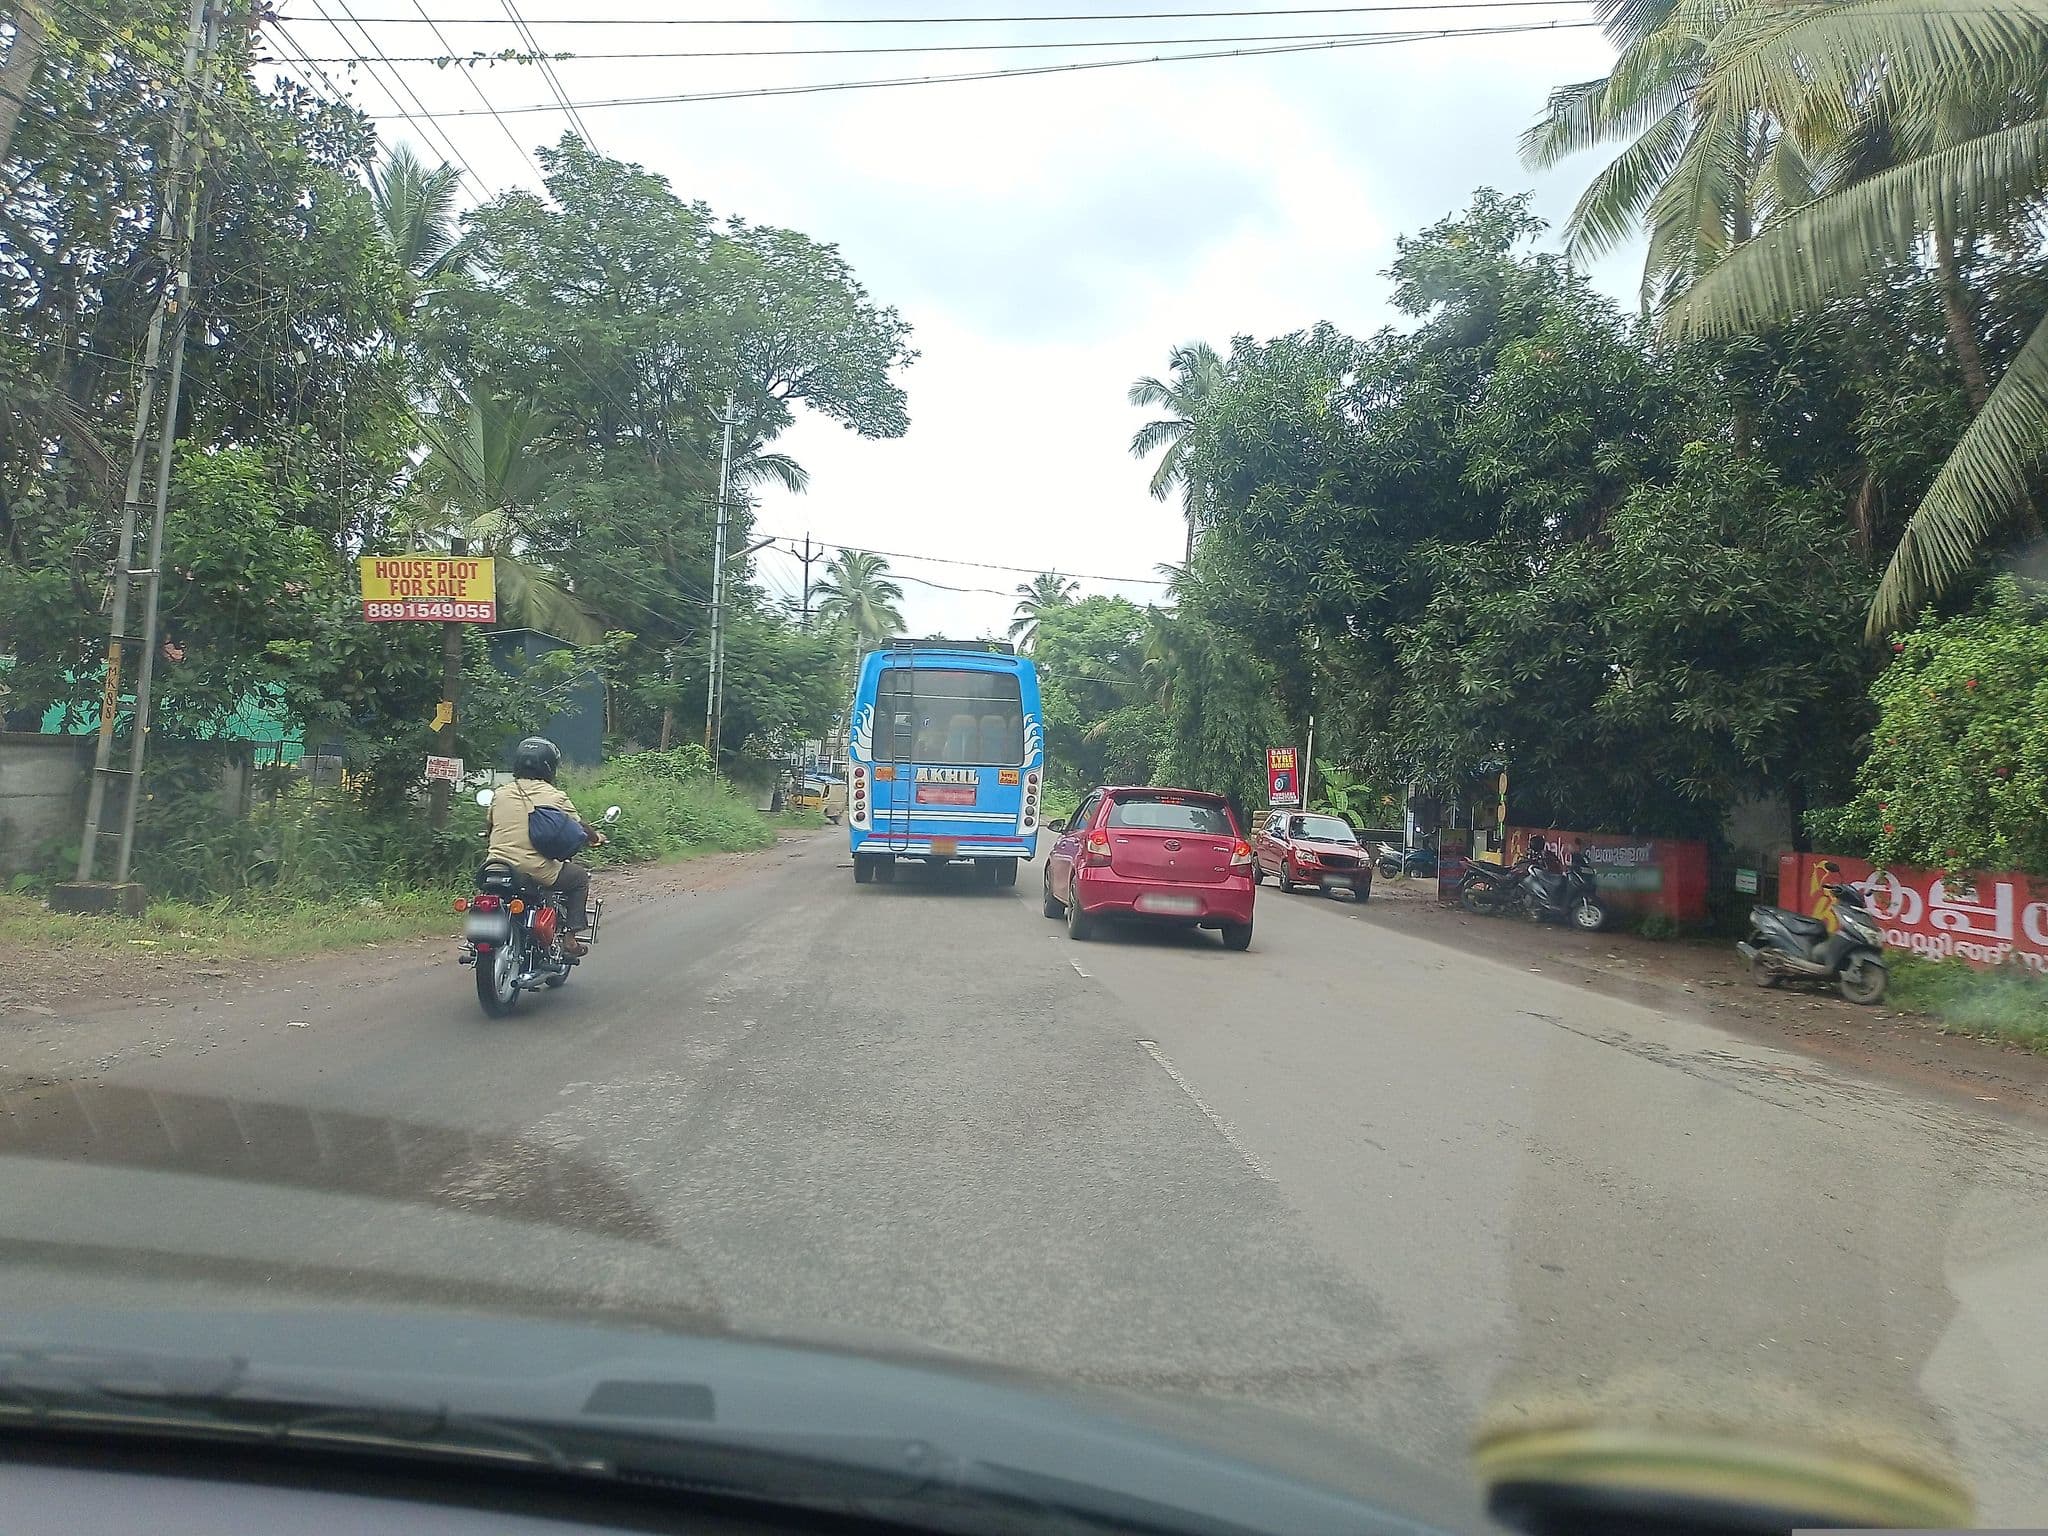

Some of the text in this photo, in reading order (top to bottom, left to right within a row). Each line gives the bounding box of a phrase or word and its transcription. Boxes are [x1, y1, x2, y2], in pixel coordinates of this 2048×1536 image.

[376, 562, 478, 580] HOUSE PLOT
[390, 580, 467, 597] FOR SALE
[367, 603, 491, 619] 8891549055
[1270, 755, 1294, 763] TYRE
[915, 767, 979, 784] AKHIL
